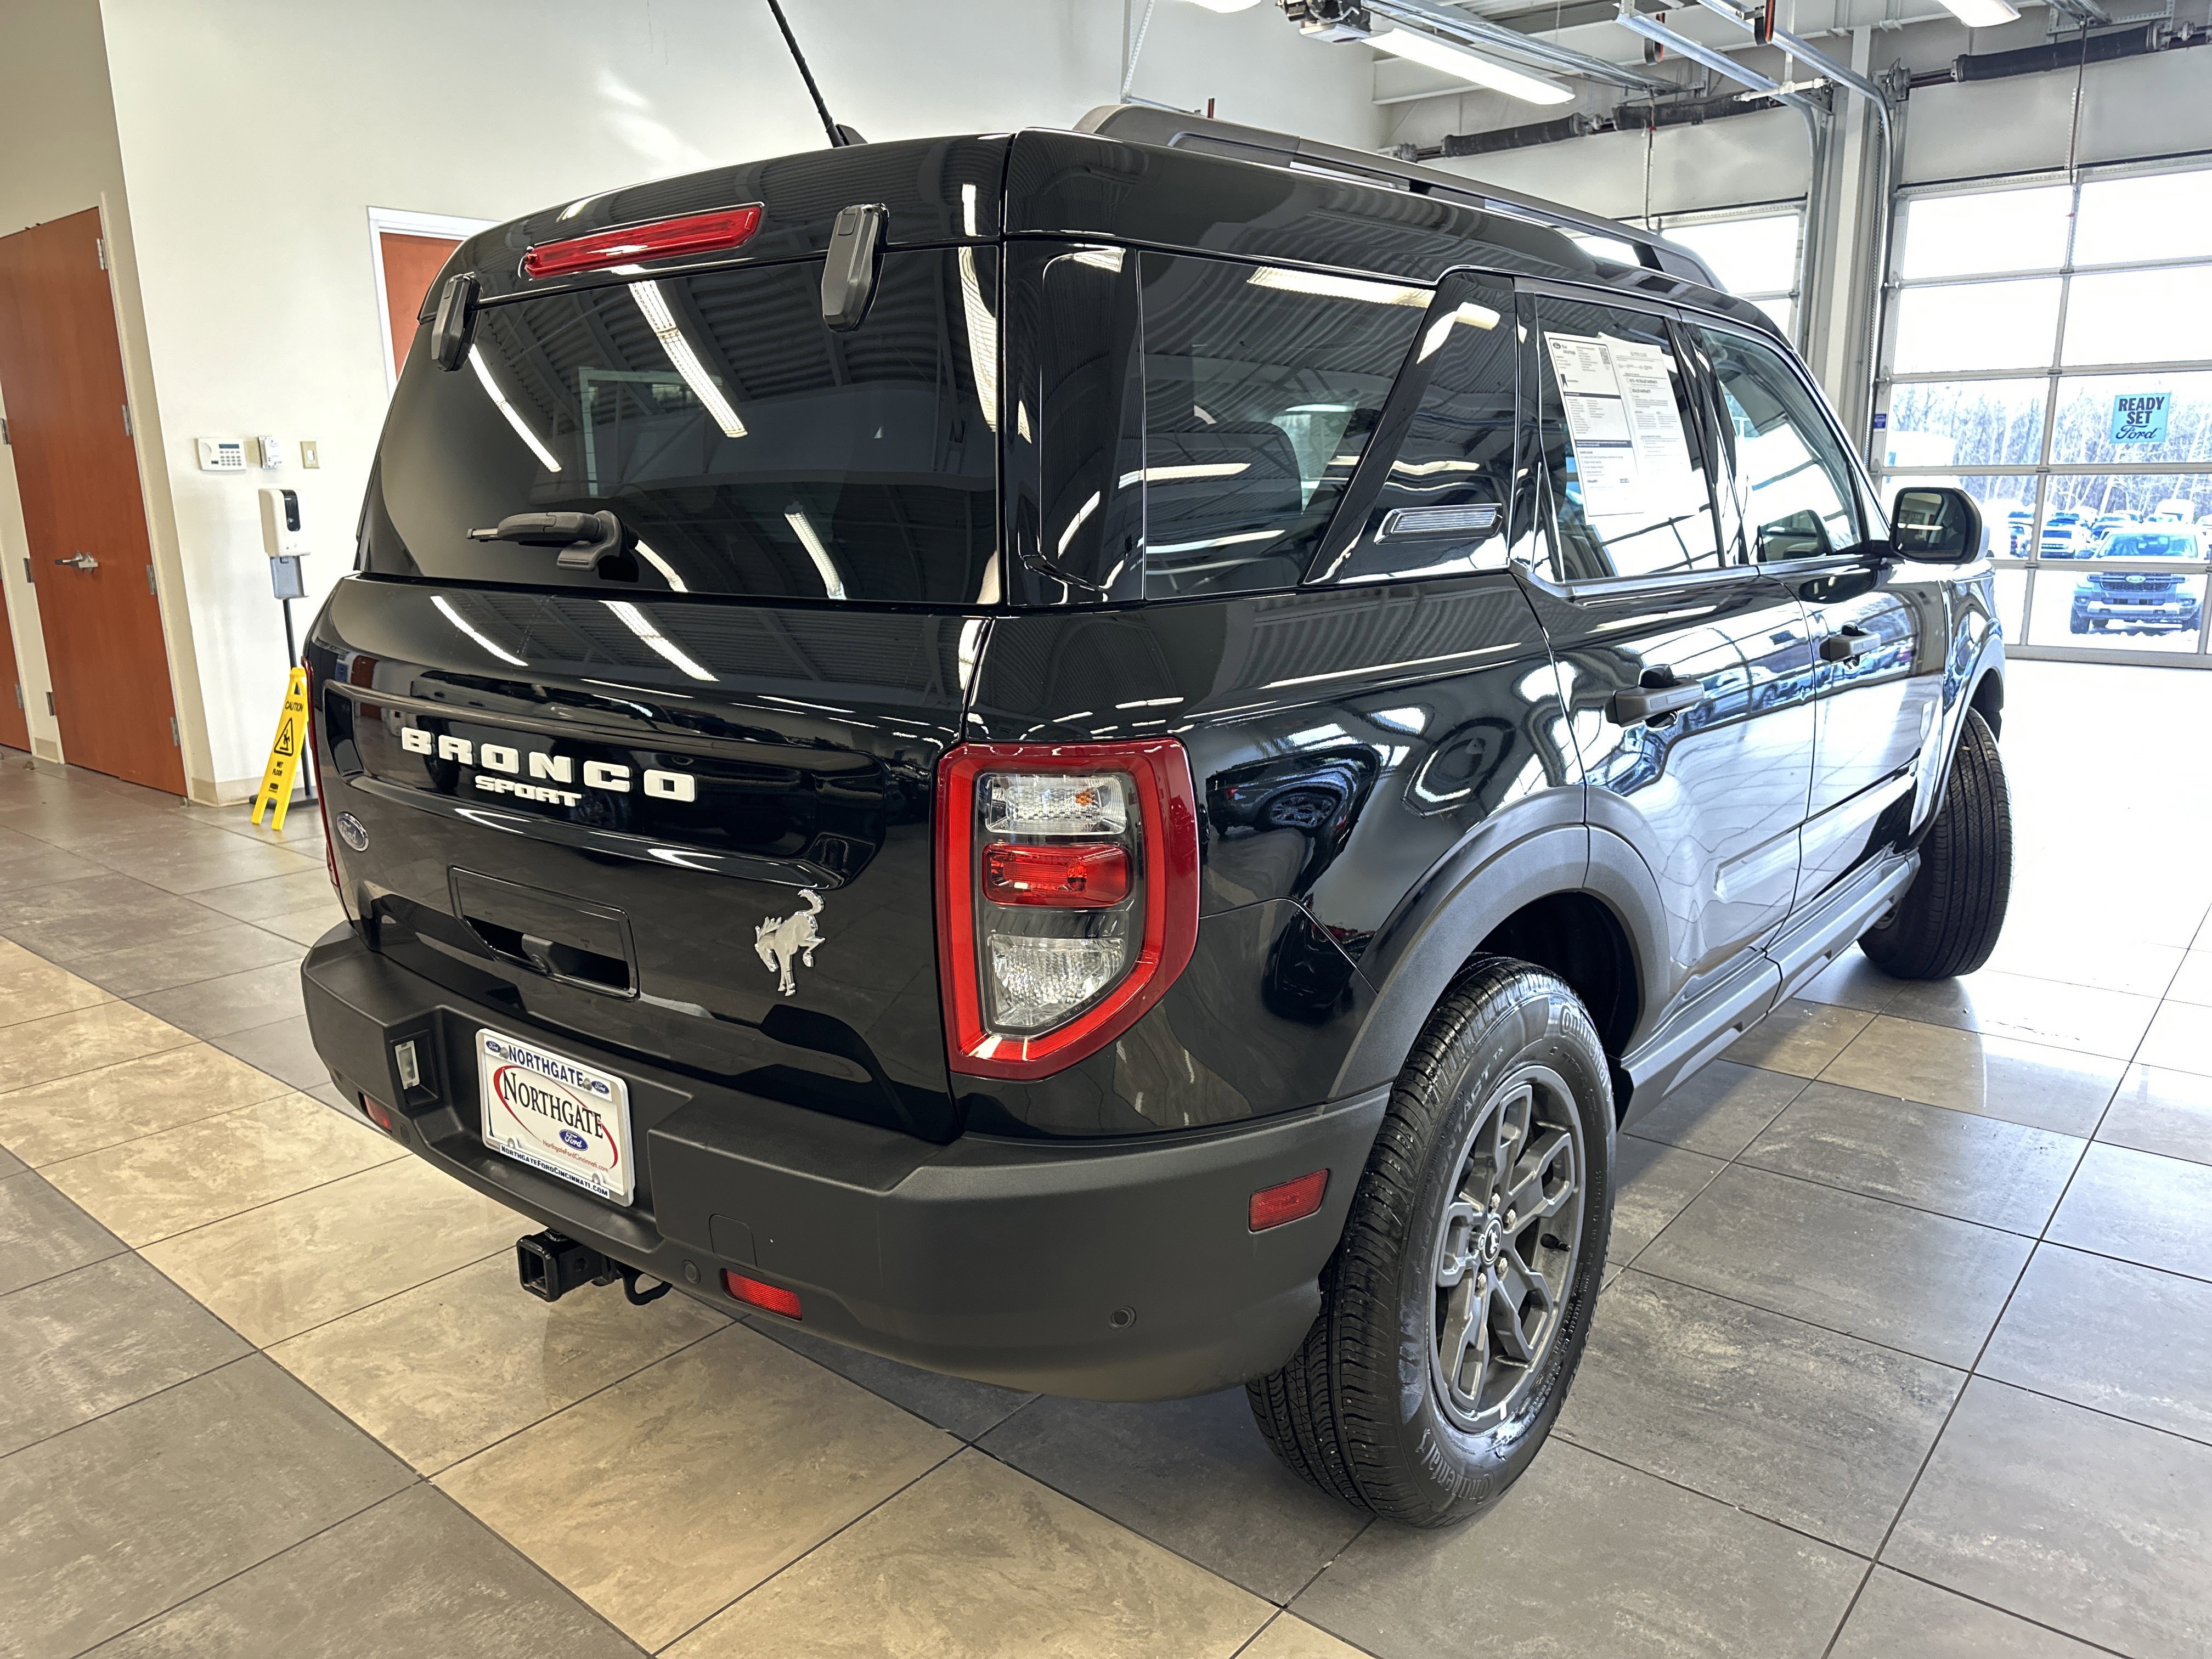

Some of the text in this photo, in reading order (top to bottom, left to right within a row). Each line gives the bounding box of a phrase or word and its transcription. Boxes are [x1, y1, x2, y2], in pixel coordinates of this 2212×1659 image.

[2118, 397, 2165, 411] READY
[2126, 411, 2152, 424] SET
[2115, 425, 2158, 439] Ford
[285, 701, 304, 713] CAUTION
[401, 727, 696, 803] BRONCO
[475, 775, 582, 806] SPORT
[509, 1045, 584, 1087] NORTHGATE
[503, 1069, 603, 1139] NORTHGATE
[543, 1139, 608, 1172] NorthgateFordCincinnati.com
